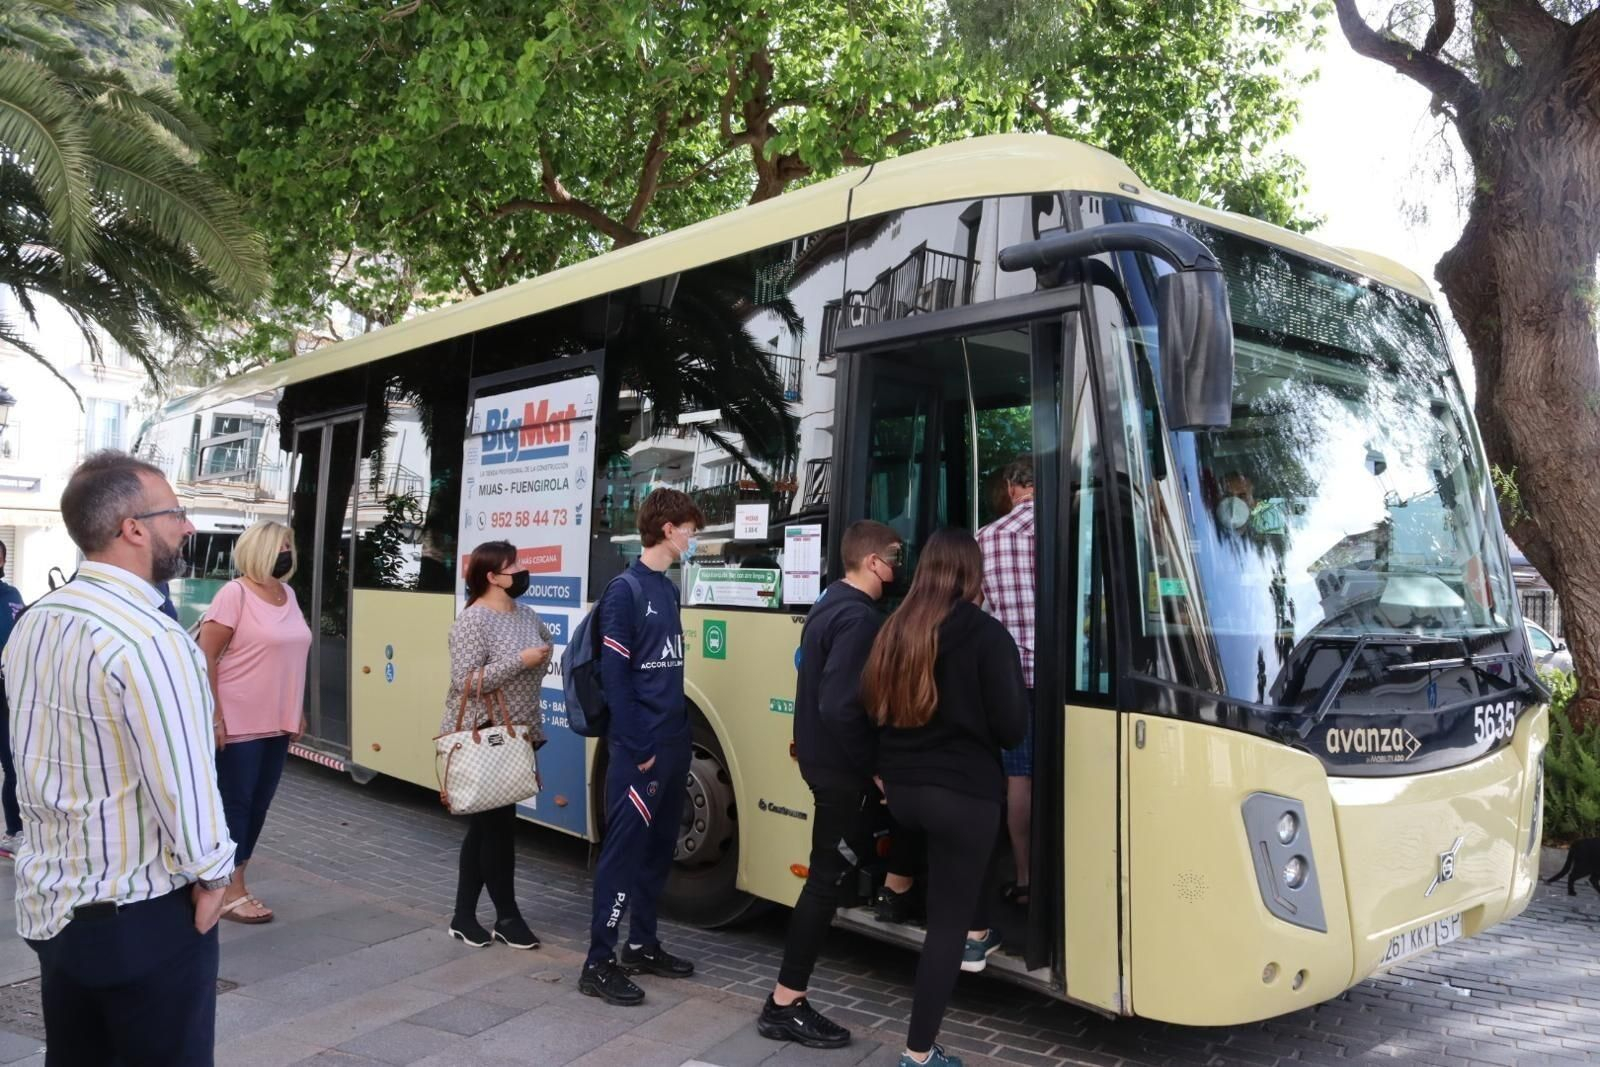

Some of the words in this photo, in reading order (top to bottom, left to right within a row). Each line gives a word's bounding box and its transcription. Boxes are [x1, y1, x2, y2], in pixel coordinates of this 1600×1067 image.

[481, 399, 577, 462] BigMat
[479, 483, 503, 497] MIJAS
[511, 477, 570, 494] FUENGIROLA
[491, 511, 513, 528] 952
[515, 510, 530, 527] 58
[532, 509, 549, 526] 44
[552, 508, 568, 526] 73
[523, 585, 570, 598] ODUCTOS
[641, 660, 667, 670] ACCOR
[1474, 701, 1515, 744] 5635
[1326, 727, 1404, 754] avanza
[606, 892, 626, 928] PARIS
[1380, 934, 1405, 963] 261
[1410, 923, 1430, 951] KKY
